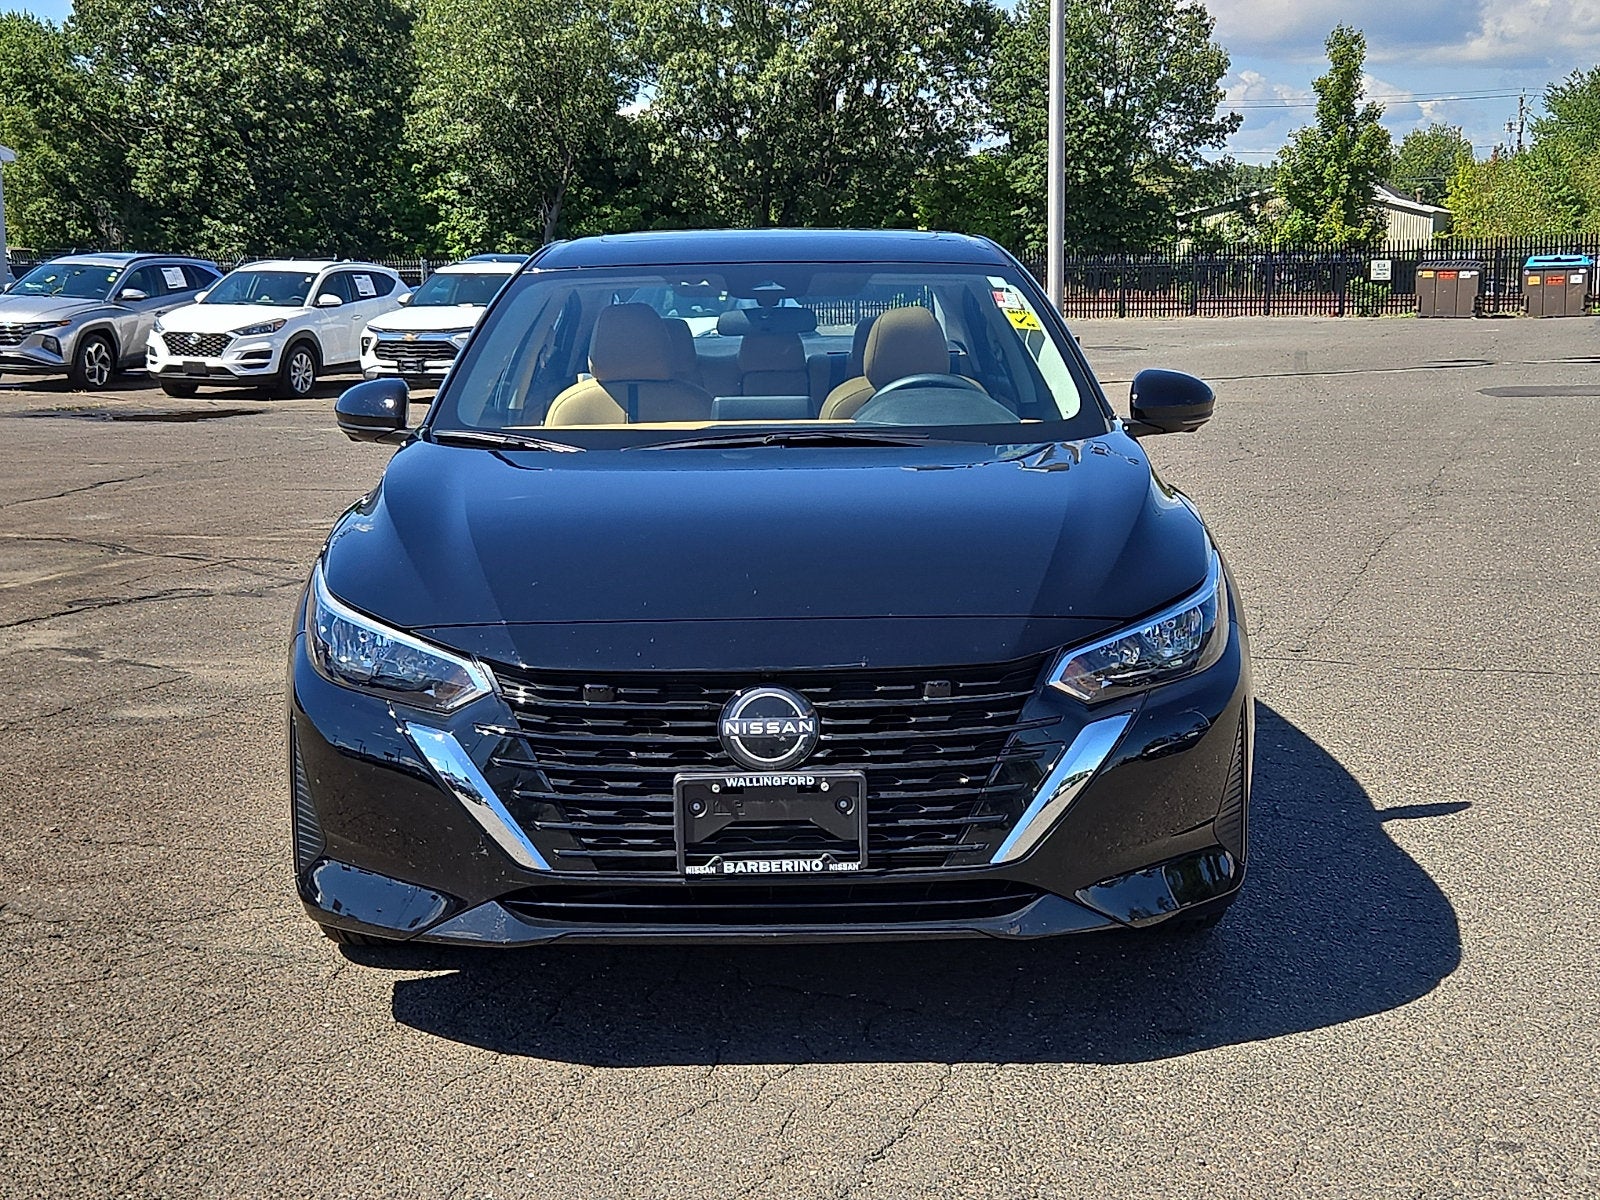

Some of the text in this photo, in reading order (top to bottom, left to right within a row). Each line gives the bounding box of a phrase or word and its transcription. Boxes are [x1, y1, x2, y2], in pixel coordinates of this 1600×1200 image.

[725, 720, 814, 735] NISSAN
[725, 776, 815, 788] WALLINGFORD
[685, 860, 859, 874] NISSAN BARBERINO NISSAN
